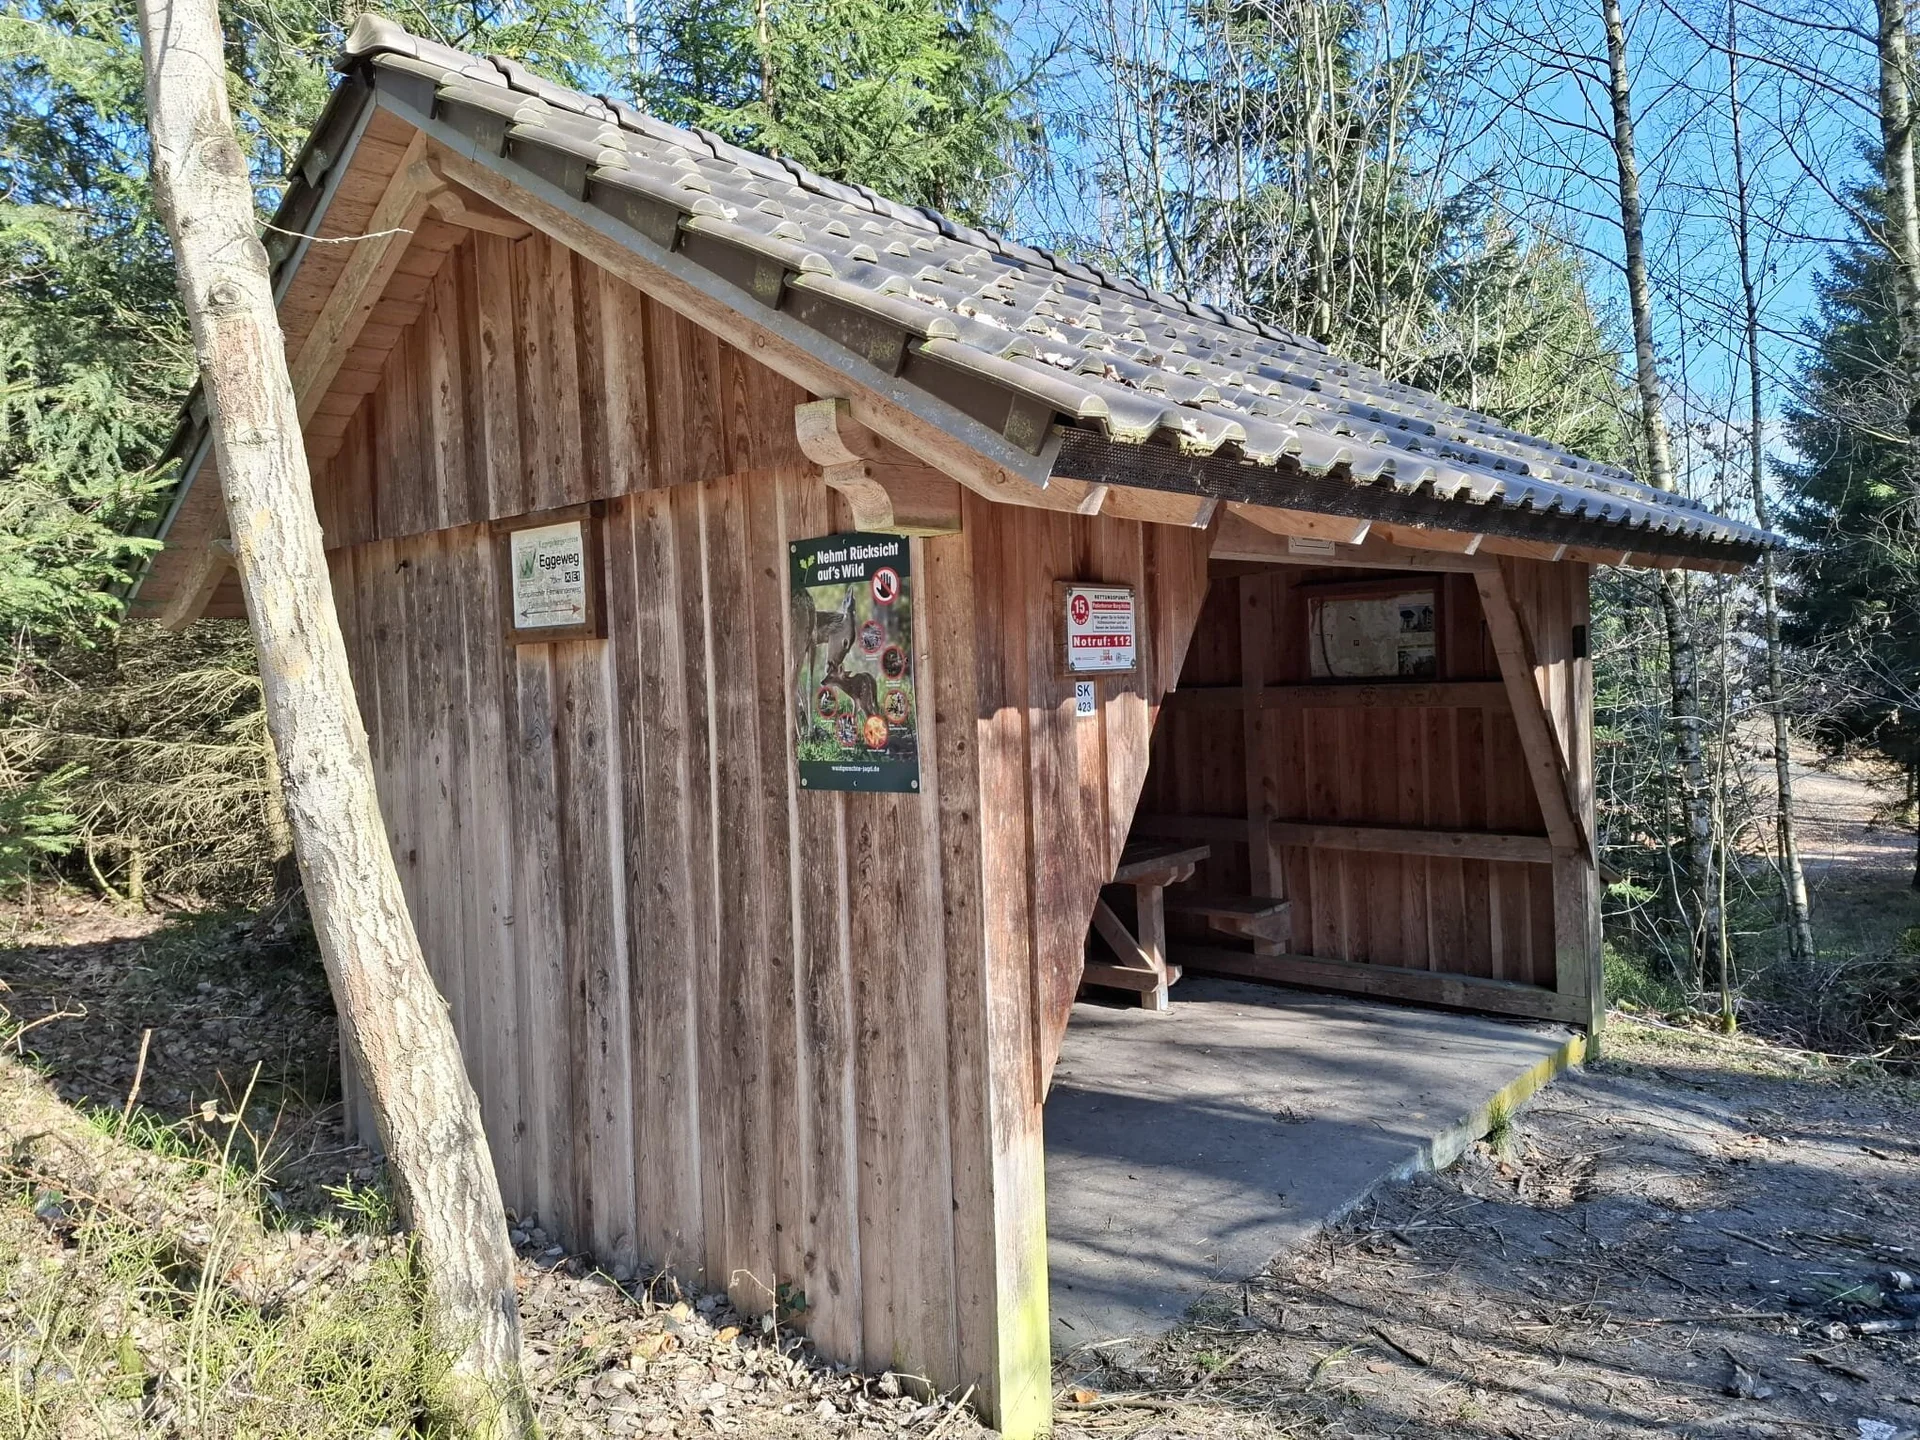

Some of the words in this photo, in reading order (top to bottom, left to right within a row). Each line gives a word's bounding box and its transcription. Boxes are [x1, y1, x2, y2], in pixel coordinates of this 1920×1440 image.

[539, 552, 579, 570] Eggeweg
[817, 548, 847, 565] Nehmt
[850, 542, 899, 560] Rücksicht
[841, 562, 865, 579] Wild
[1074, 599, 1086, 614] 15
[1073, 636, 1111, 647] Notruf:
[1114, 636, 1131, 646] 112
[1077, 684, 1091, 697] SK
[1077, 701, 1092, 713] 423
